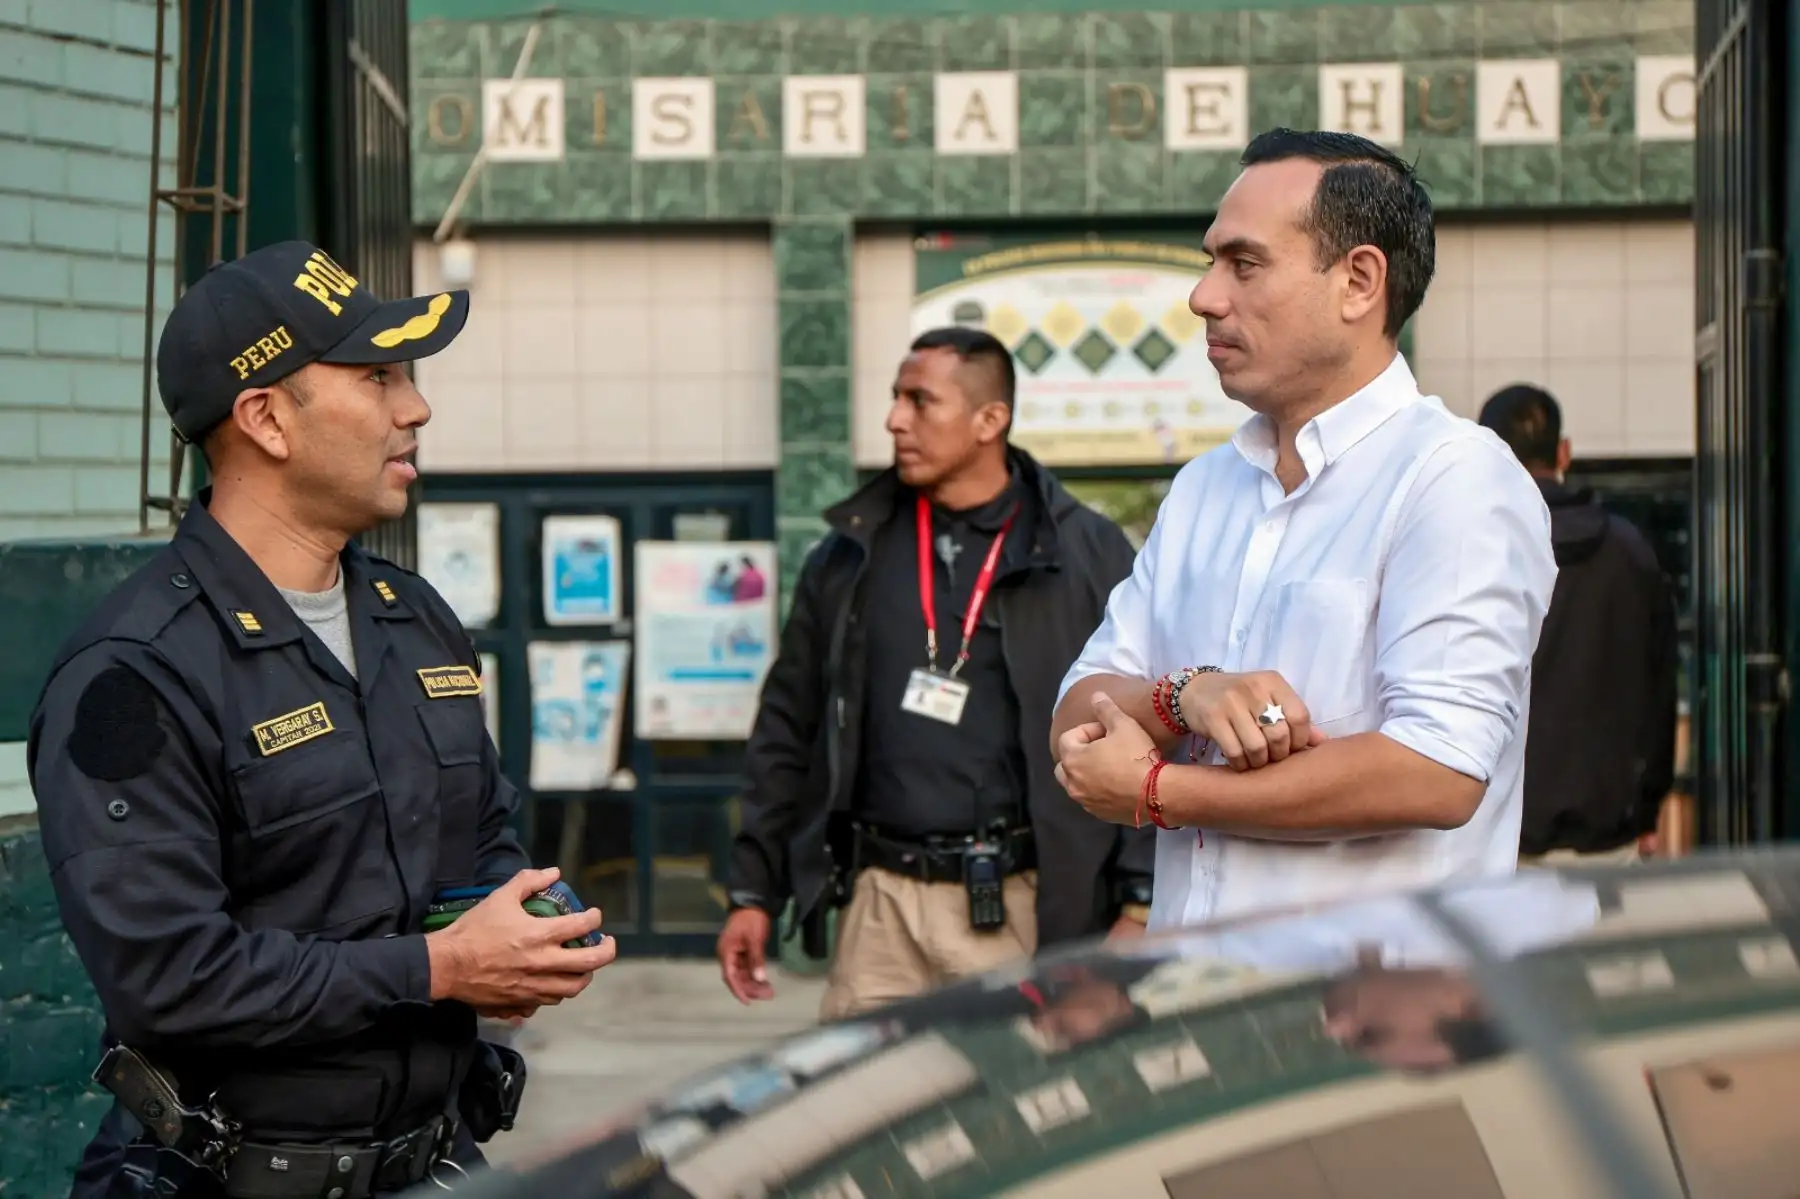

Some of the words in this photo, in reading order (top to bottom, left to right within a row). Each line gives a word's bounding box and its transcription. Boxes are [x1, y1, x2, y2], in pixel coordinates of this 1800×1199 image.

[1106, 81, 1234, 141] DE
[293, 249, 359, 317] POL
[229, 325, 293, 381] PERU
[259, 728, 272, 742] M.
[270, 712, 312, 737] VERGARAY
[312, 710, 324, 722] S.
[270, 730, 303, 748] CAPITAN
